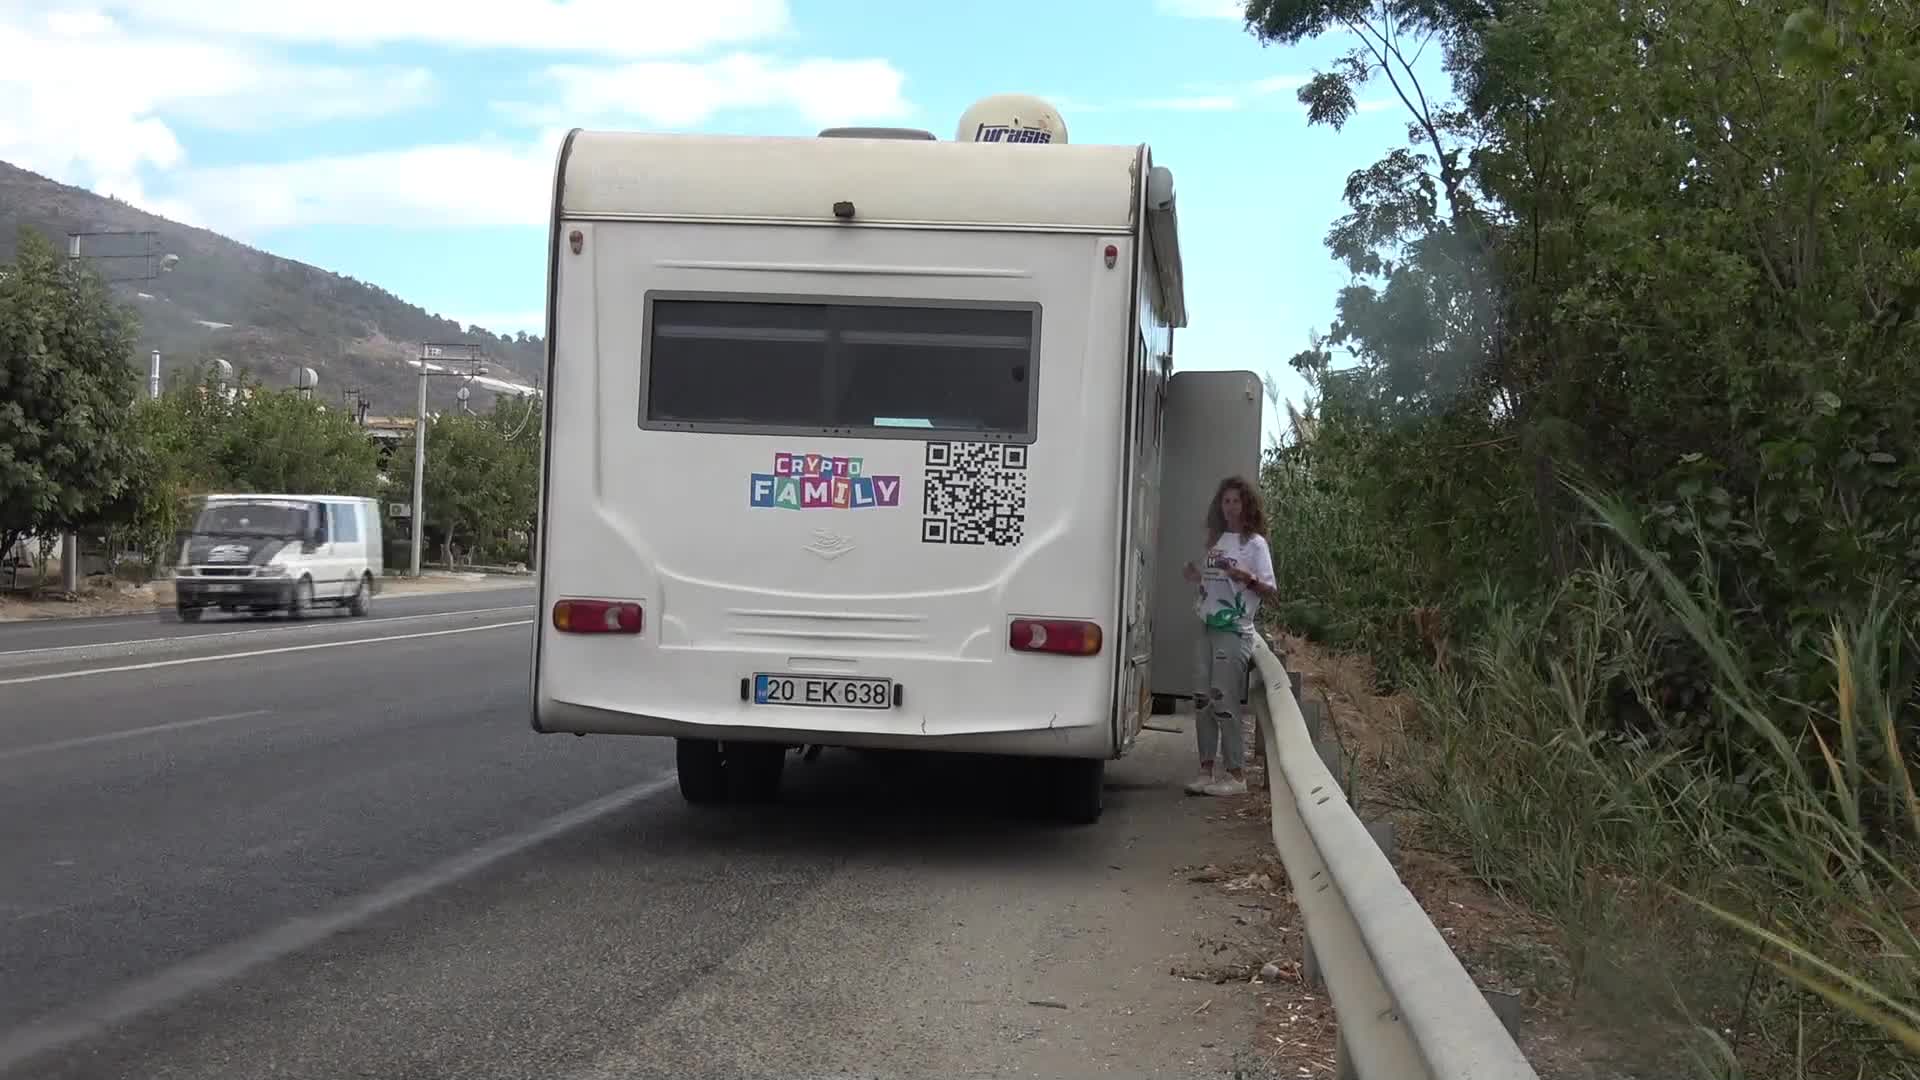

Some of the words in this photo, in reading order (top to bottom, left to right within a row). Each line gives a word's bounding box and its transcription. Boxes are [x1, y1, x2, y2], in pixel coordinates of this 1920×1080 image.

[775, 456, 861, 475] CRYPTO
[754, 479, 898, 505] FAMILY
[768, 680, 794, 701] 20
[806, 681, 838, 703] EK
[844, 683, 886, 704] 638
